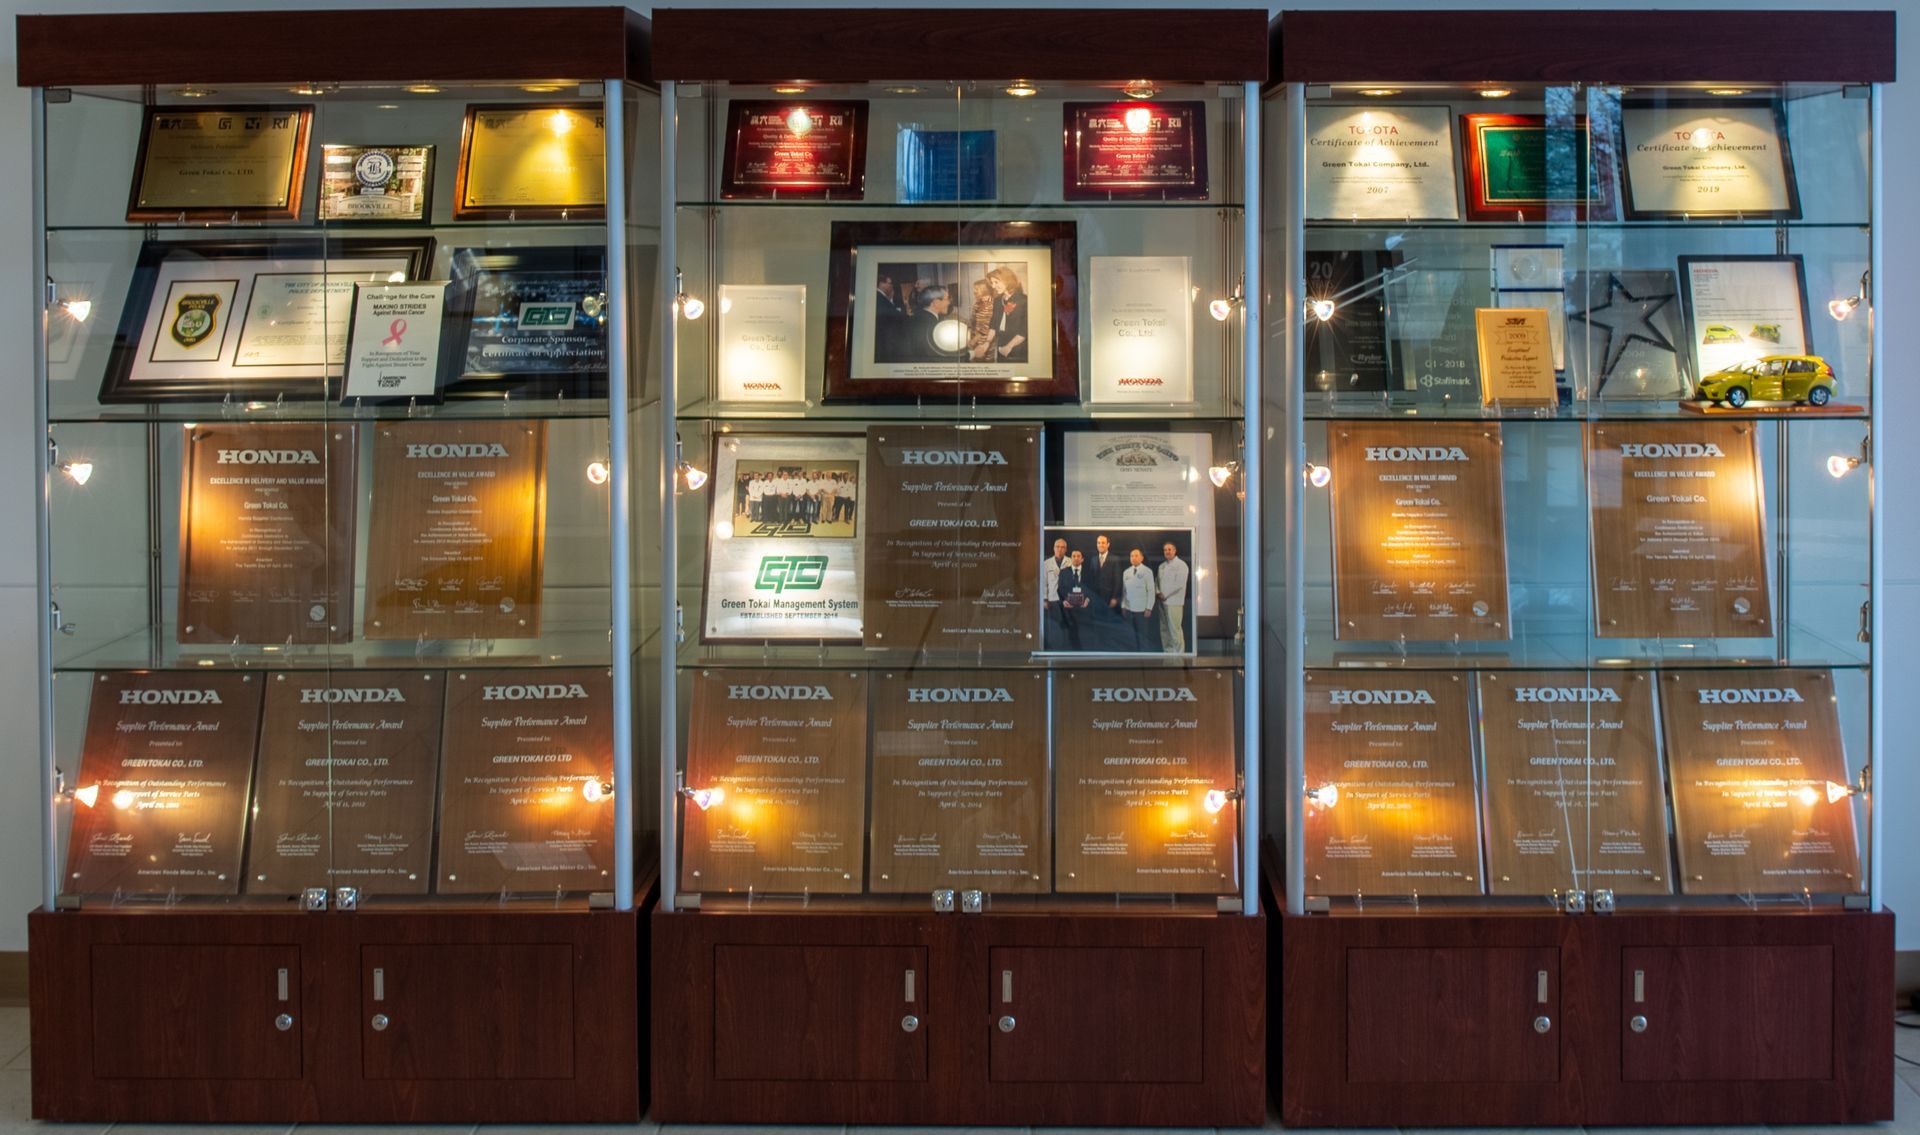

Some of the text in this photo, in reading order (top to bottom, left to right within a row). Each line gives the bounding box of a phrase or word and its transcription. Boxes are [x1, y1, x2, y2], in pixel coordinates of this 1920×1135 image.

[1349, 126, 1399, 134] TOOTA
[1311, 139, 1361, 147] Certificate
[1637, 144, 1689, 152] Certificate
[1311, 262, 1333, 279] 20
[502, 336, 586, 344] Corporate Sponsor
[1358, 354, 1382, 362] Ryder
[1118, 378, 1163, 386] HONDA
[1434, 376, 1471, 385] Staffmark
[217, 450, 320, 464] HONDA
[406, 444, 509, 458] HONDA
[1365, 447, 1469, 461] HONDA
[1620, 444, 1725, 457] HONDA
[902, 451, 1008, 464] HONDA
[902, 481, 1008, 493] Supplier Performance Award
[722, 600, 858, 610] Green Tokai Management System
[120, 690, 222, 704] HONDA
[300, 688, 405, 703] HONDA
[483, 684, 588, 700] HONDA
[728, 685, 833, 700] HONDA
[908, 688, 1014, 702] HONDA
[1092, 688, 1197, 702] HONDA
[1329, 690, 1435, 704] HONDA
[1515, 688, 1622, 702] HONDA
[1699, 688, 1804, 704] HONDA
[116, 721, 219, 733] Supplier Performance Award
[481, 716, 587, 729] Supplier Performance Award
[907, 720, 1013, 732] Supplier Performance Award
[1331, 721, 1437, 733] Supplier Performance Award
[1702, 720, 1808, 732] Supplier Performance Award
[121, 759, 204, 768] GREEN TOKAI CO., LTD.
